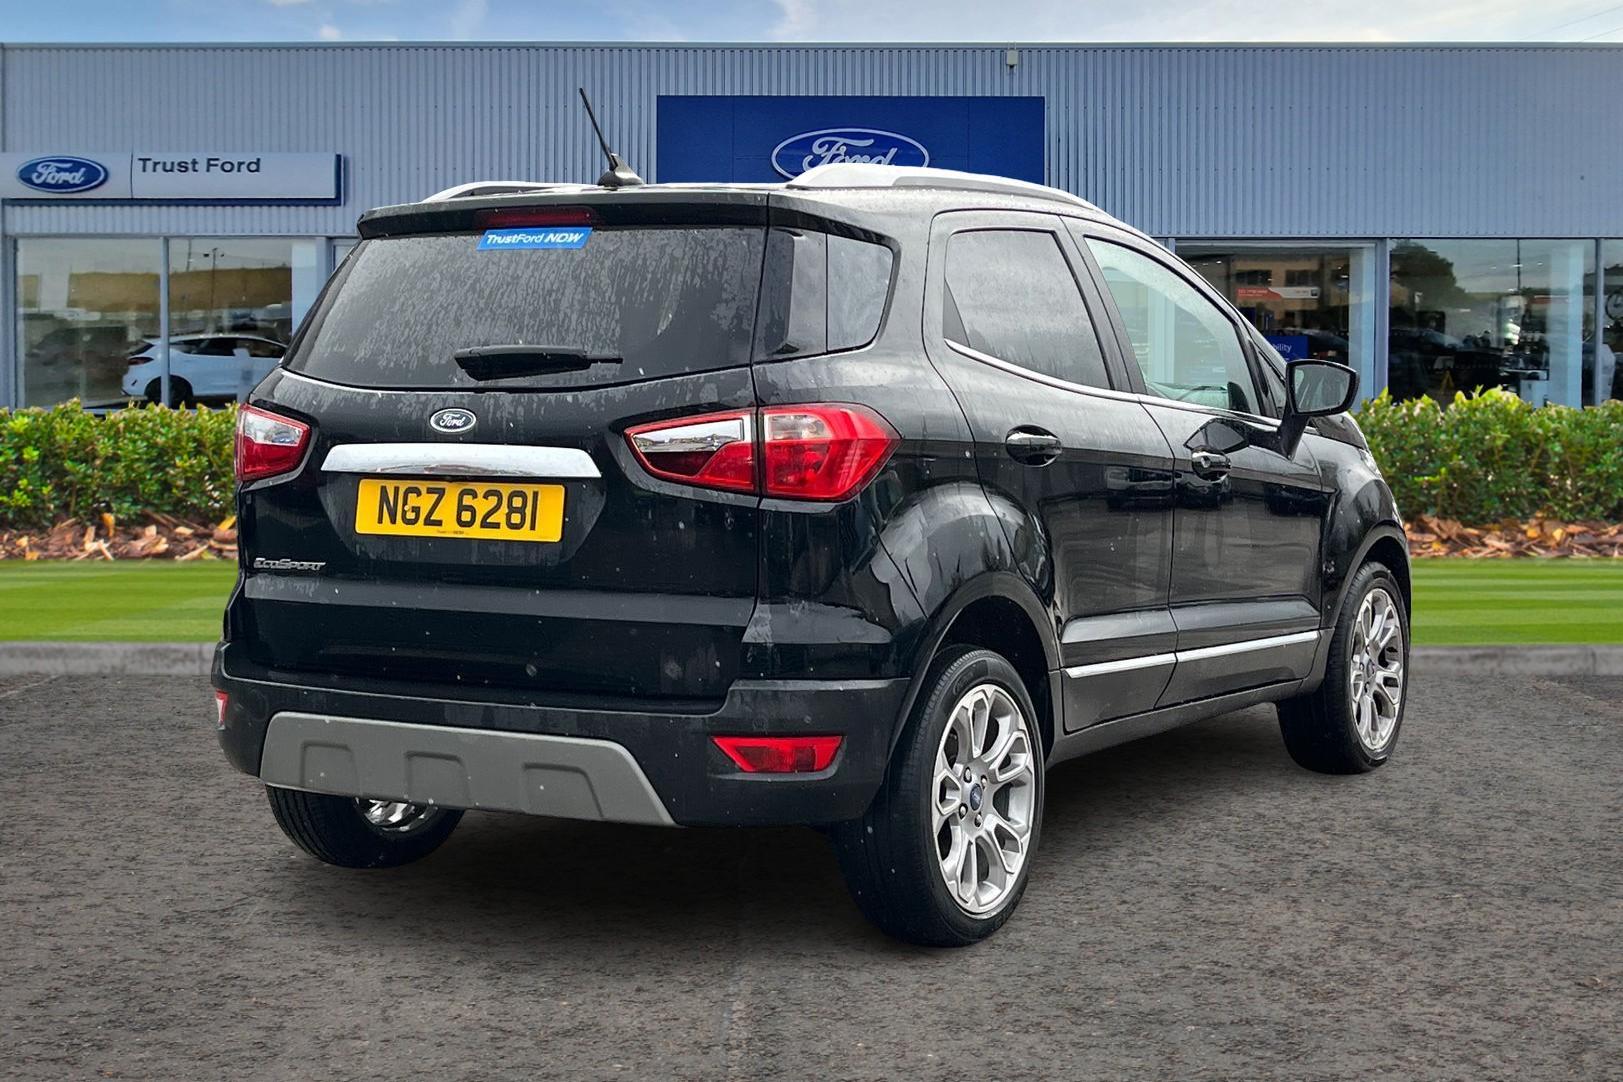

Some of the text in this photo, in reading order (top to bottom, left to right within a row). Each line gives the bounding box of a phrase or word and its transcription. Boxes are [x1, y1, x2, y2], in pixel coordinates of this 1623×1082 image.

[31, 161, 86, 184] Ford
[137, 157, 261, 173] Trust Ford
[487, 232, 584, 244] TrustFord NOW
[440, 413, 466, 426] Ford
[377, 485, 539, 531] NGZ 6281
